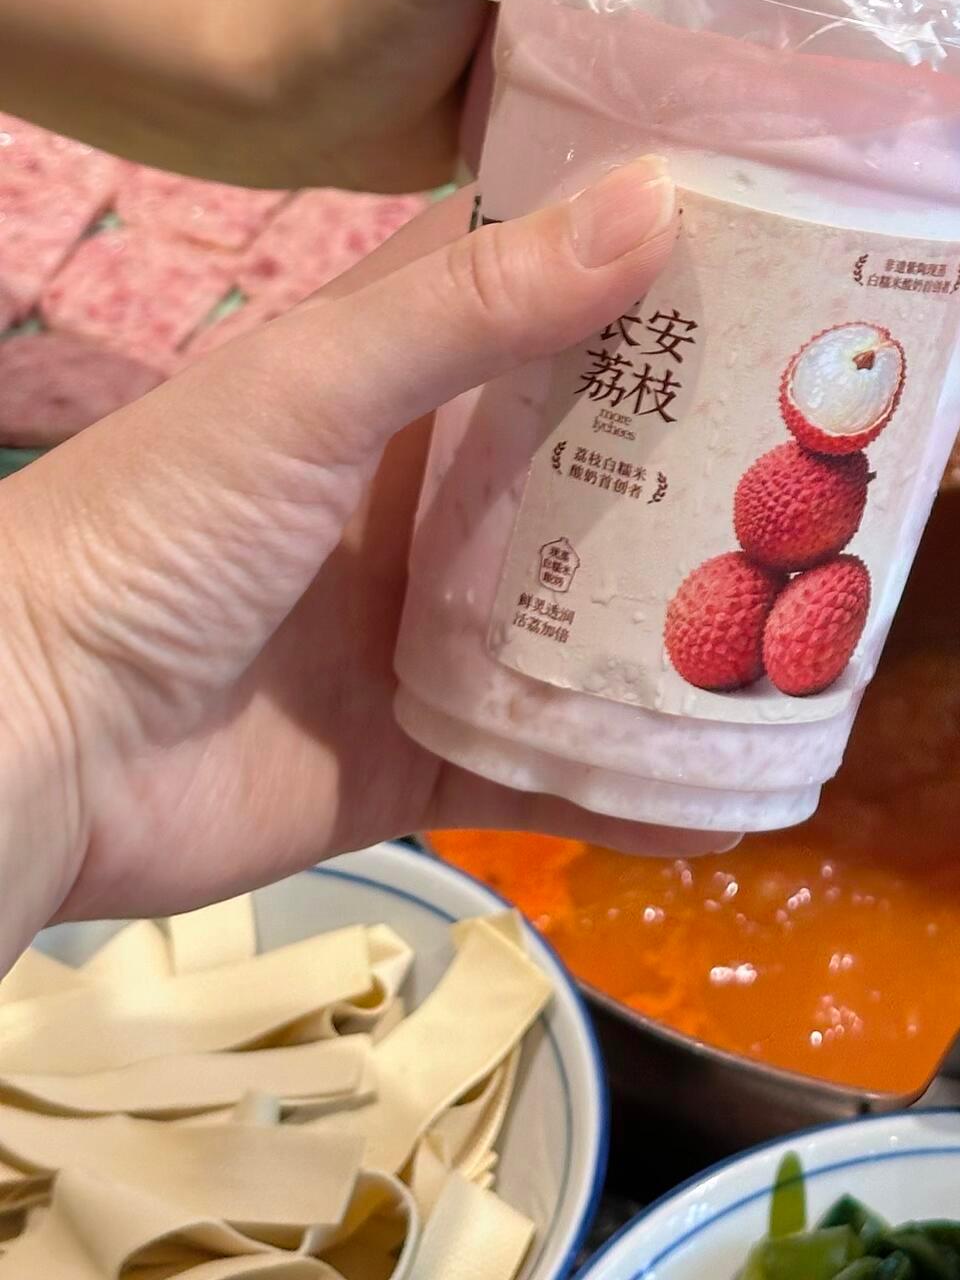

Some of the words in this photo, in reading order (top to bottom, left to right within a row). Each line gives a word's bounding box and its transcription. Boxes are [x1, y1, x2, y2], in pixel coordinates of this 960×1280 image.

[573, 348, 683, 423] 荔枝
[600, 407, 633, 426] more
[568, 463, 644, 500] 酸奶首创者
[573, 446, 648, 482] 荔枝白糯米
